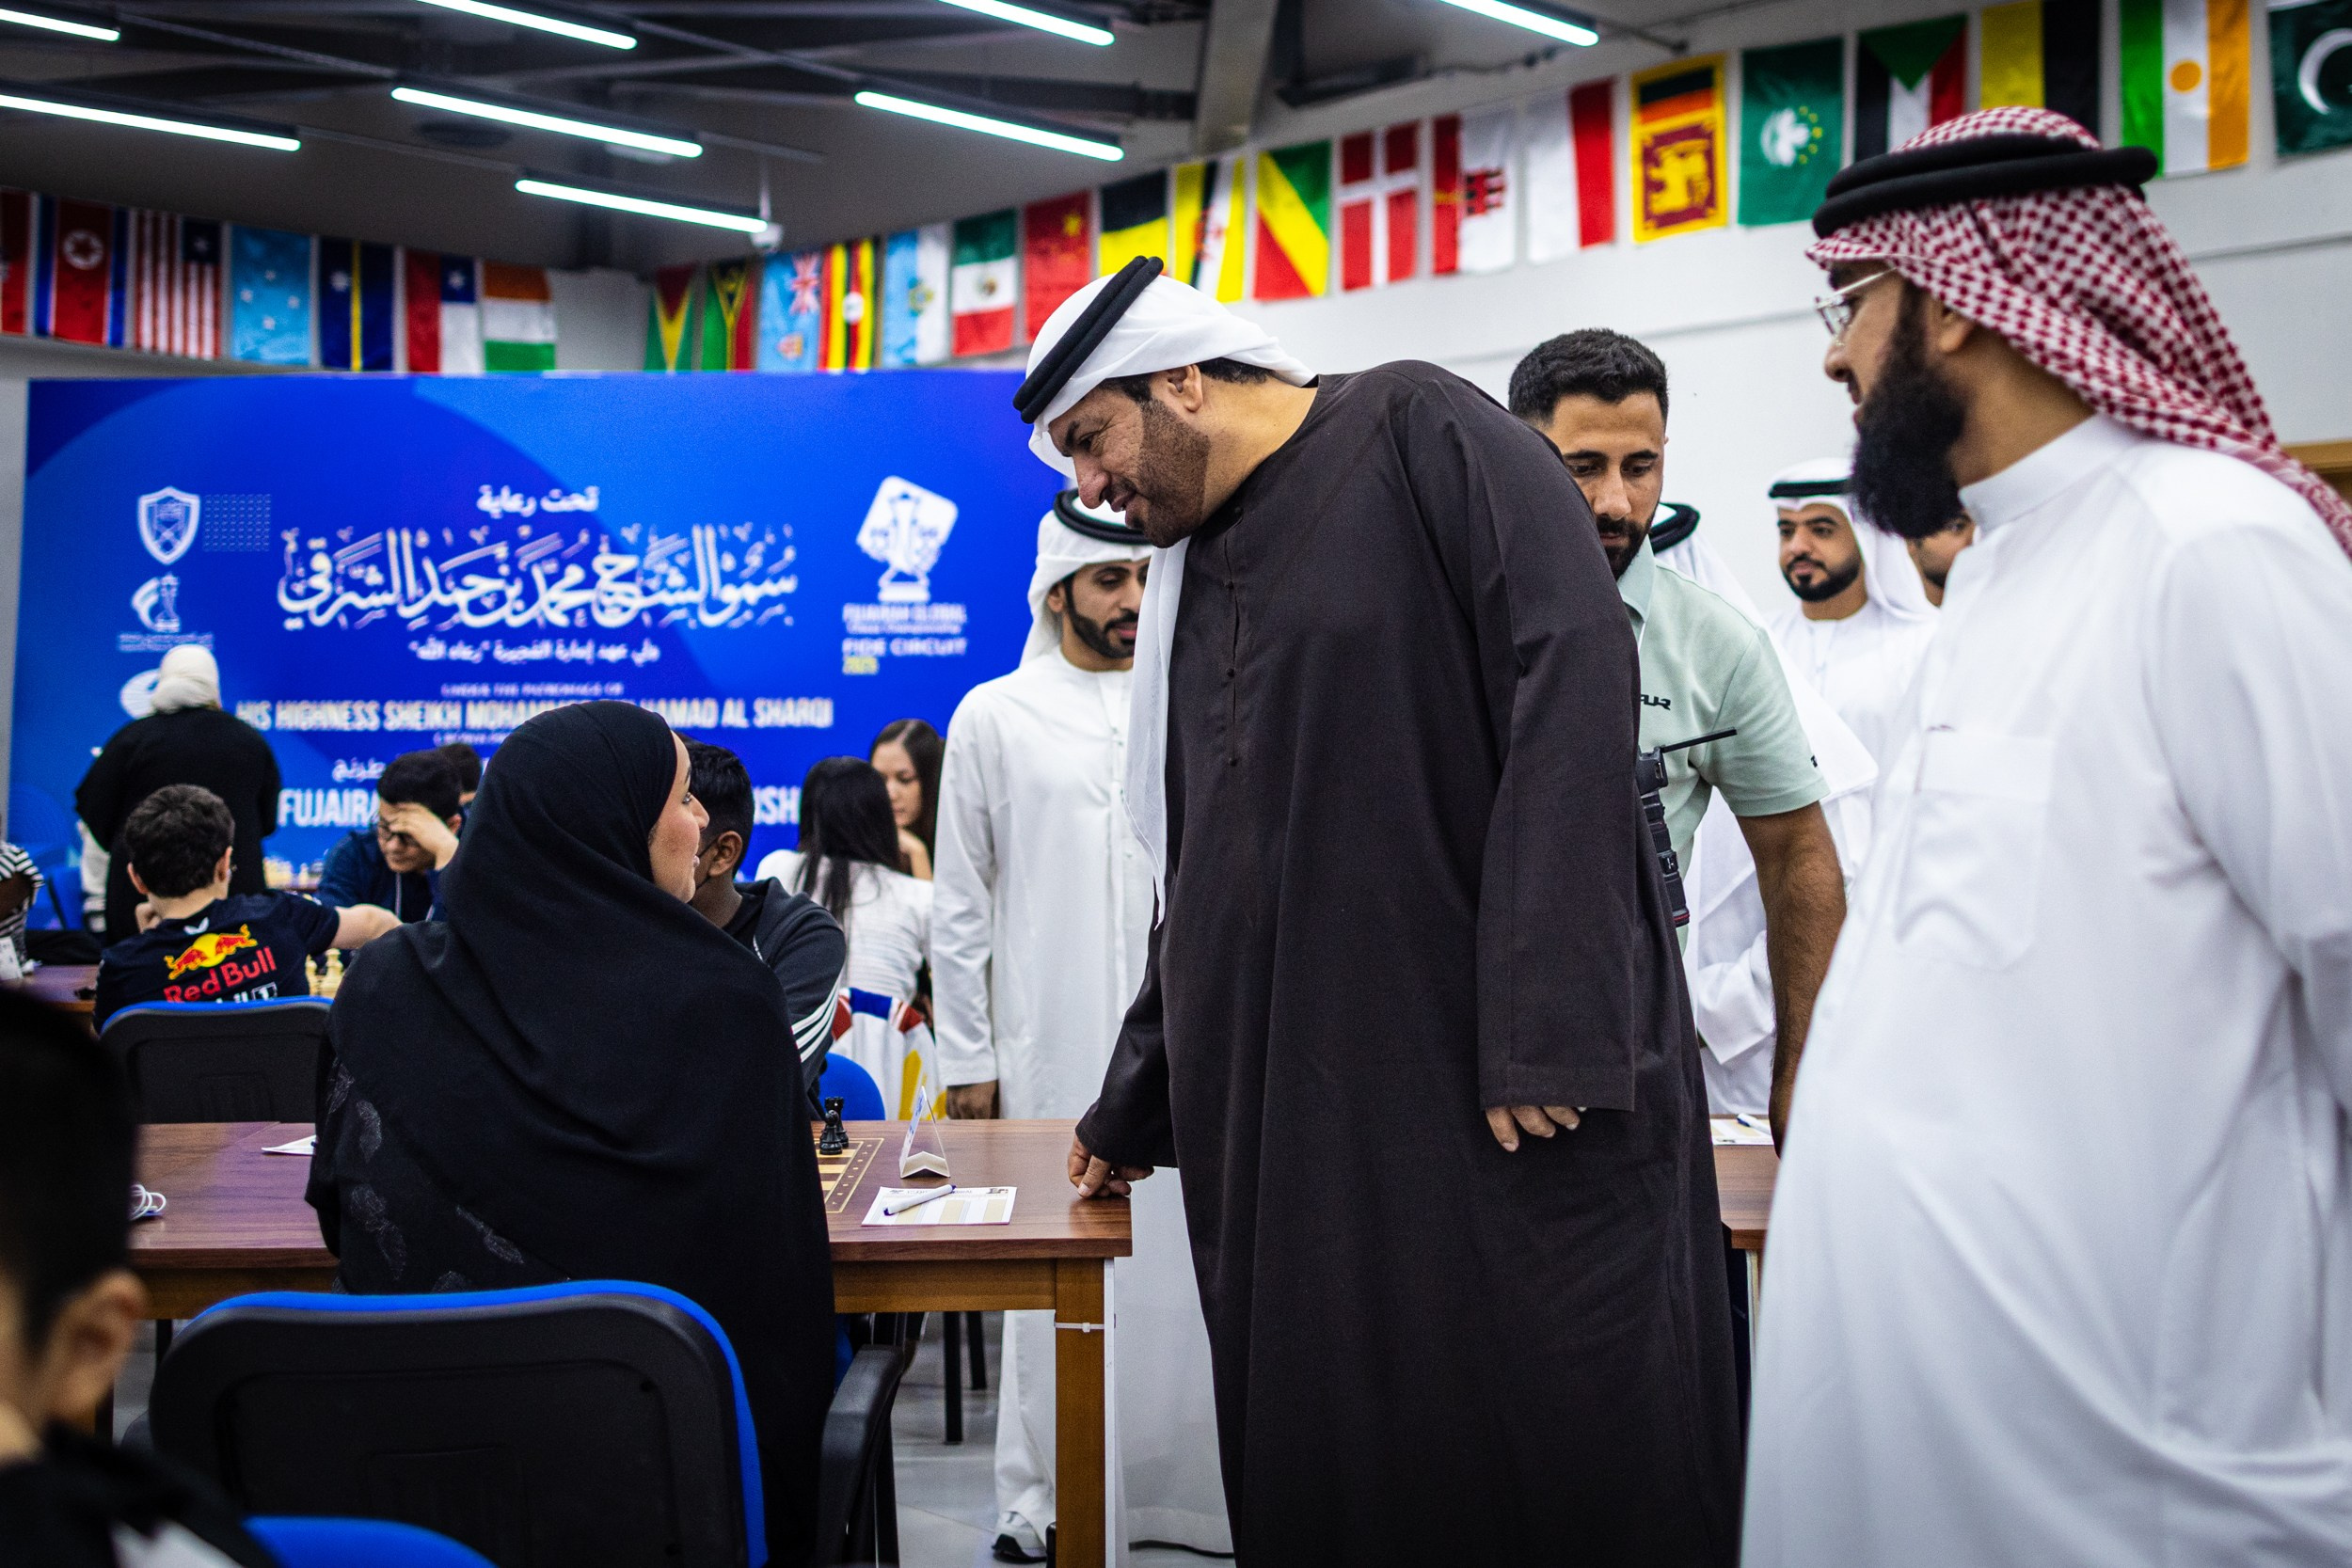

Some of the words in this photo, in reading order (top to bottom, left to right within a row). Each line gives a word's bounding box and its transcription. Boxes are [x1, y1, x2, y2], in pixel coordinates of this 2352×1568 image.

[476, 484, 537, 518] رعاية
[540, 485, 600, 513] تحت
[275, 699, 381, 732] HIGHNESS
[383, 699, 462, 732] SHEIKH
[721, 697, 751, 728] AL
[753, 696, 834, 728] SHARQI
[278, 787, 380, 827] FUJAIRA
[163, 969, 221, 1002] Red
[220, 946, 277, 987] Bull
